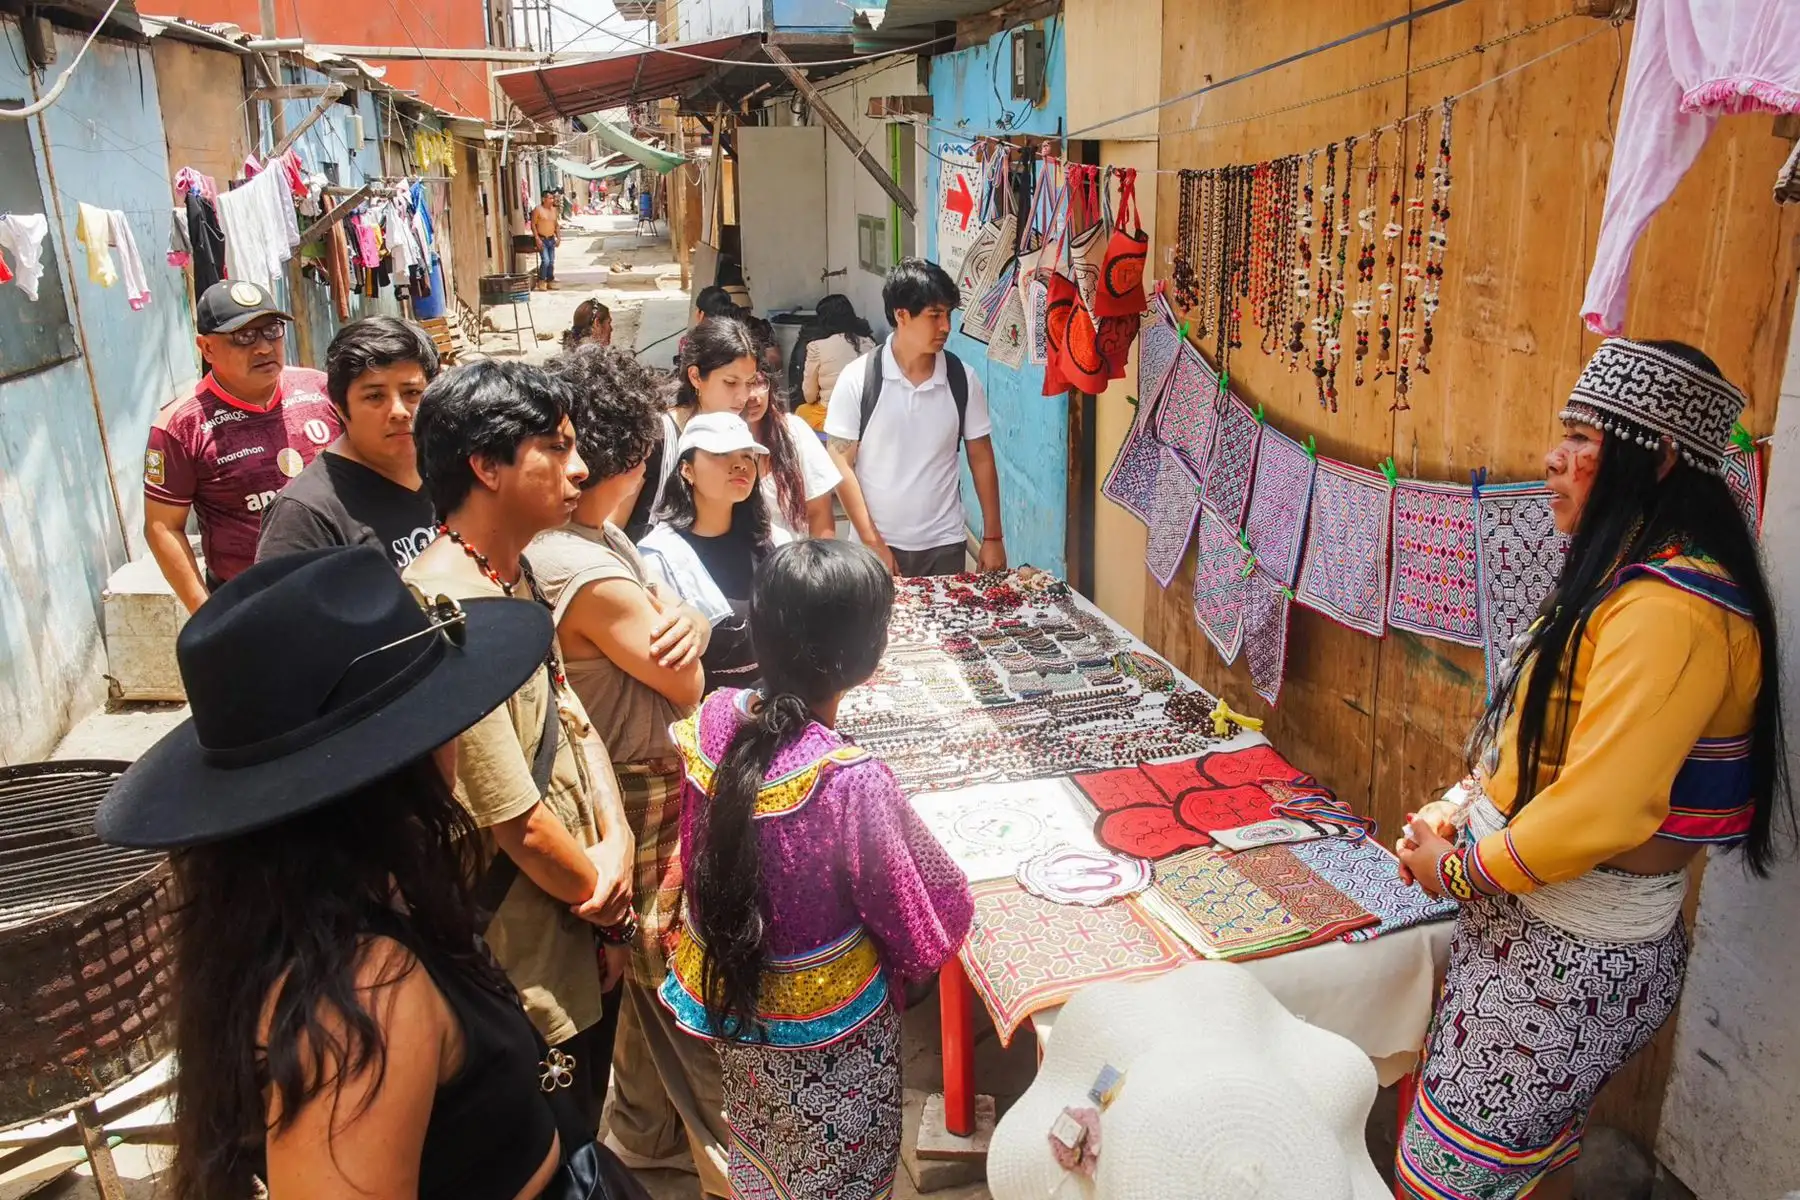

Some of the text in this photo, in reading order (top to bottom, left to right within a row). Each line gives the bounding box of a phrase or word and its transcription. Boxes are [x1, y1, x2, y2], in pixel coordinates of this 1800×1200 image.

[200, 410, 246, 433] SAN CARLOS
[216, 445, 265, 465] marathon
